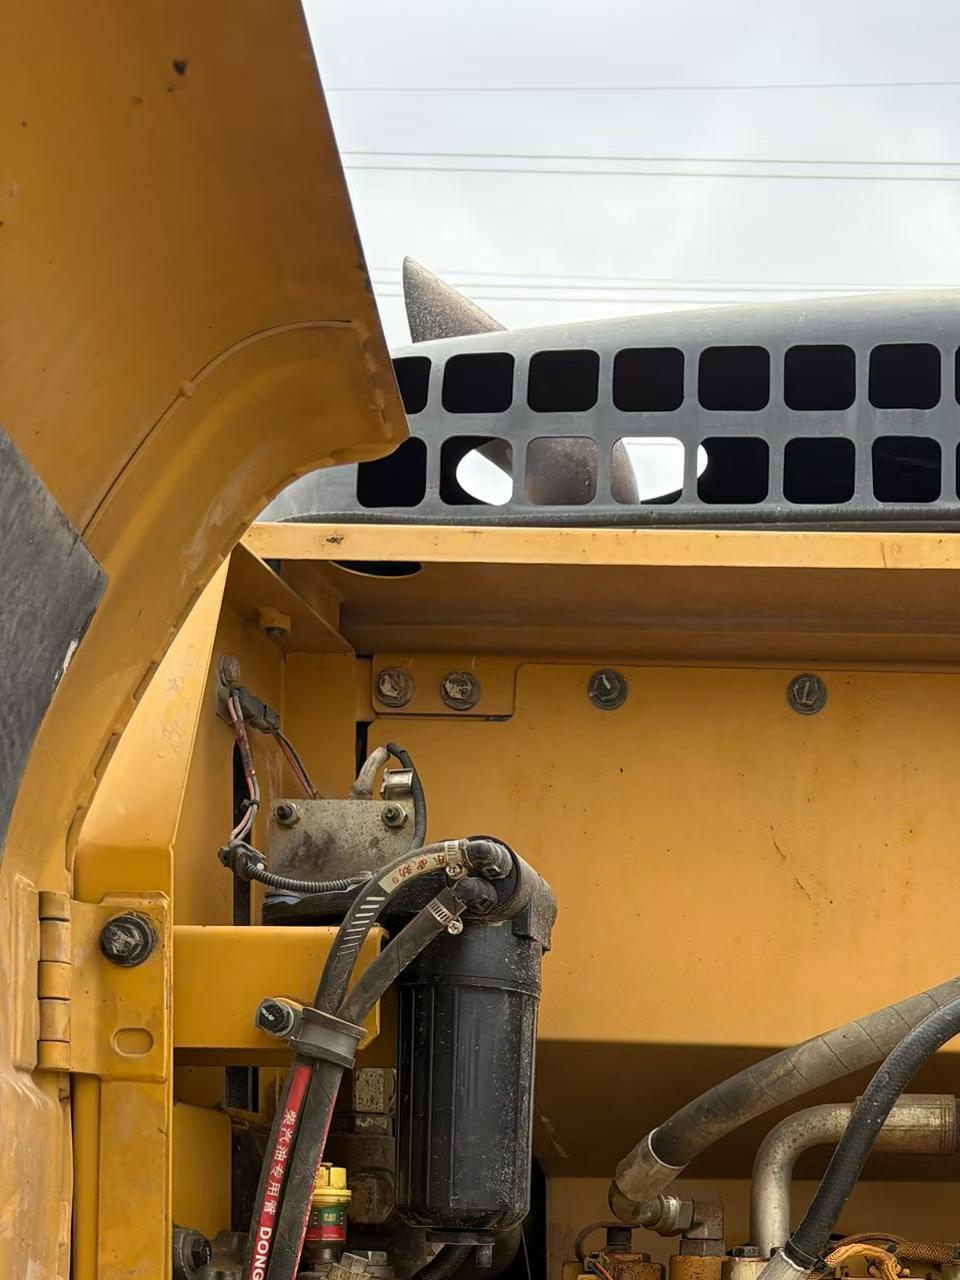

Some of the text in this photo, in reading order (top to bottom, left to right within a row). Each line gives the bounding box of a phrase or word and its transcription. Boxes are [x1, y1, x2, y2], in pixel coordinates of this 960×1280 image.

[262, 1108, 297, 1216] 柴汽油专用管
